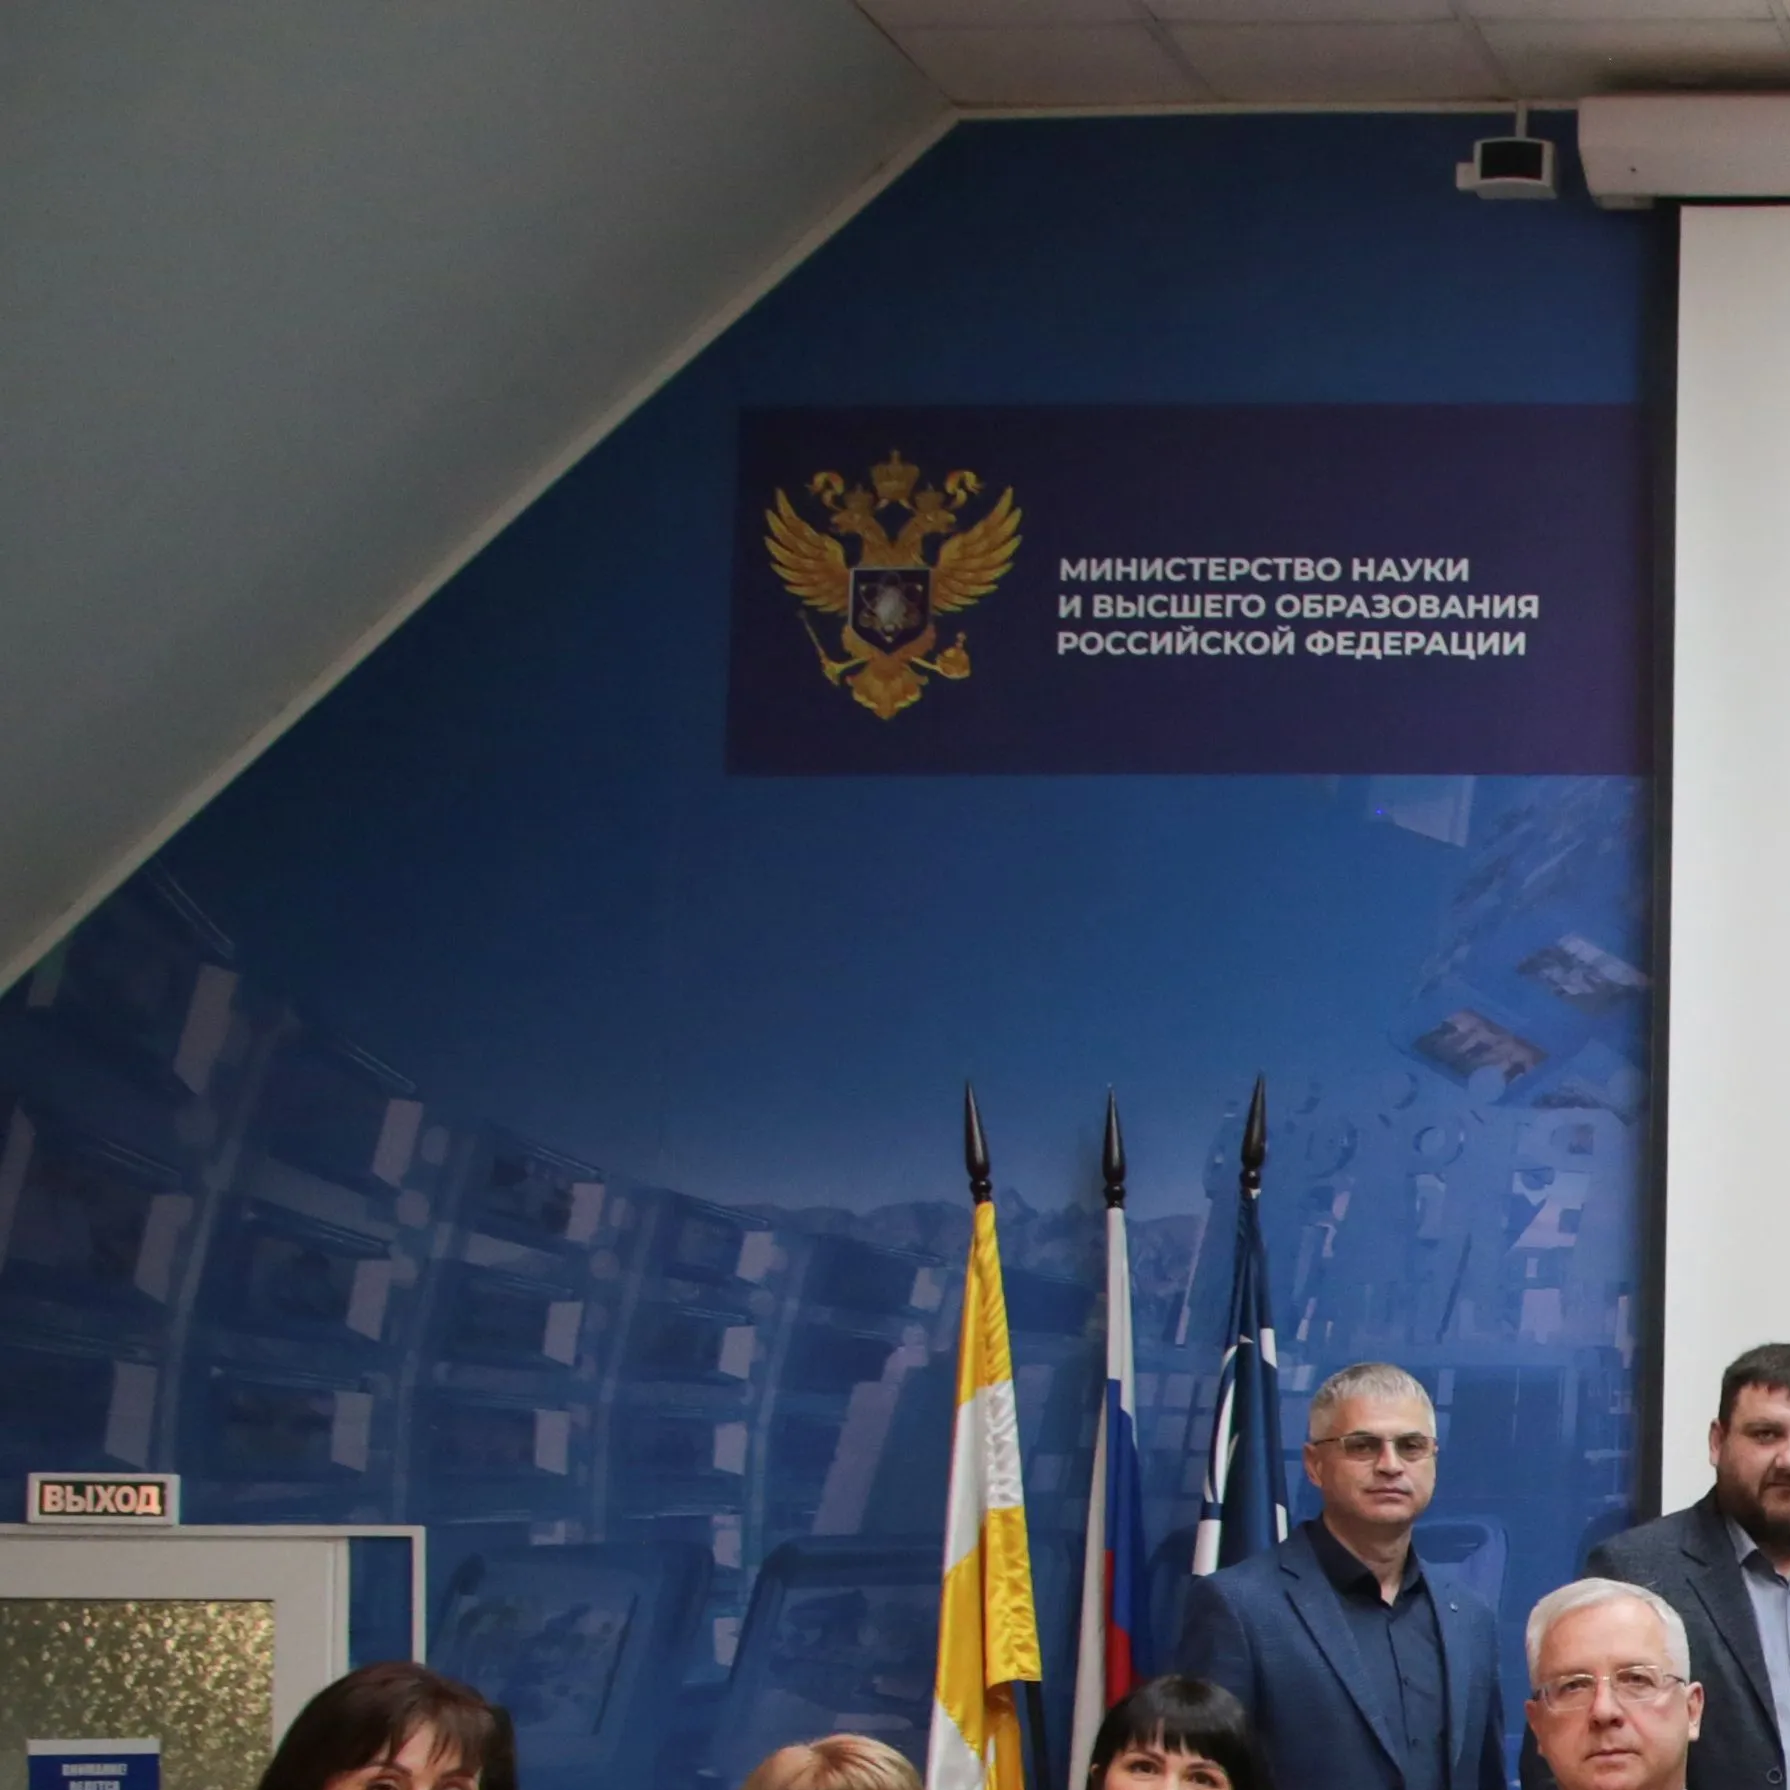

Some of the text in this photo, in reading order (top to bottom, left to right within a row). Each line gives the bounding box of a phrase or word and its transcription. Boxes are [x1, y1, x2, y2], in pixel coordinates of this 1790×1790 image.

[1059, 557, 1470, 582] МИНИСТЕРСТВО НАУКИ
[1058, 593, 1540, 619] И ВЫСШЕГО ОБРАЗОВАНИЯ
[1057, 625, 1527, 660] РОССИЙСКОЙ ФЕДЕРАЦИИ
[42, 1483, 162, 1515] ВЫХОД
